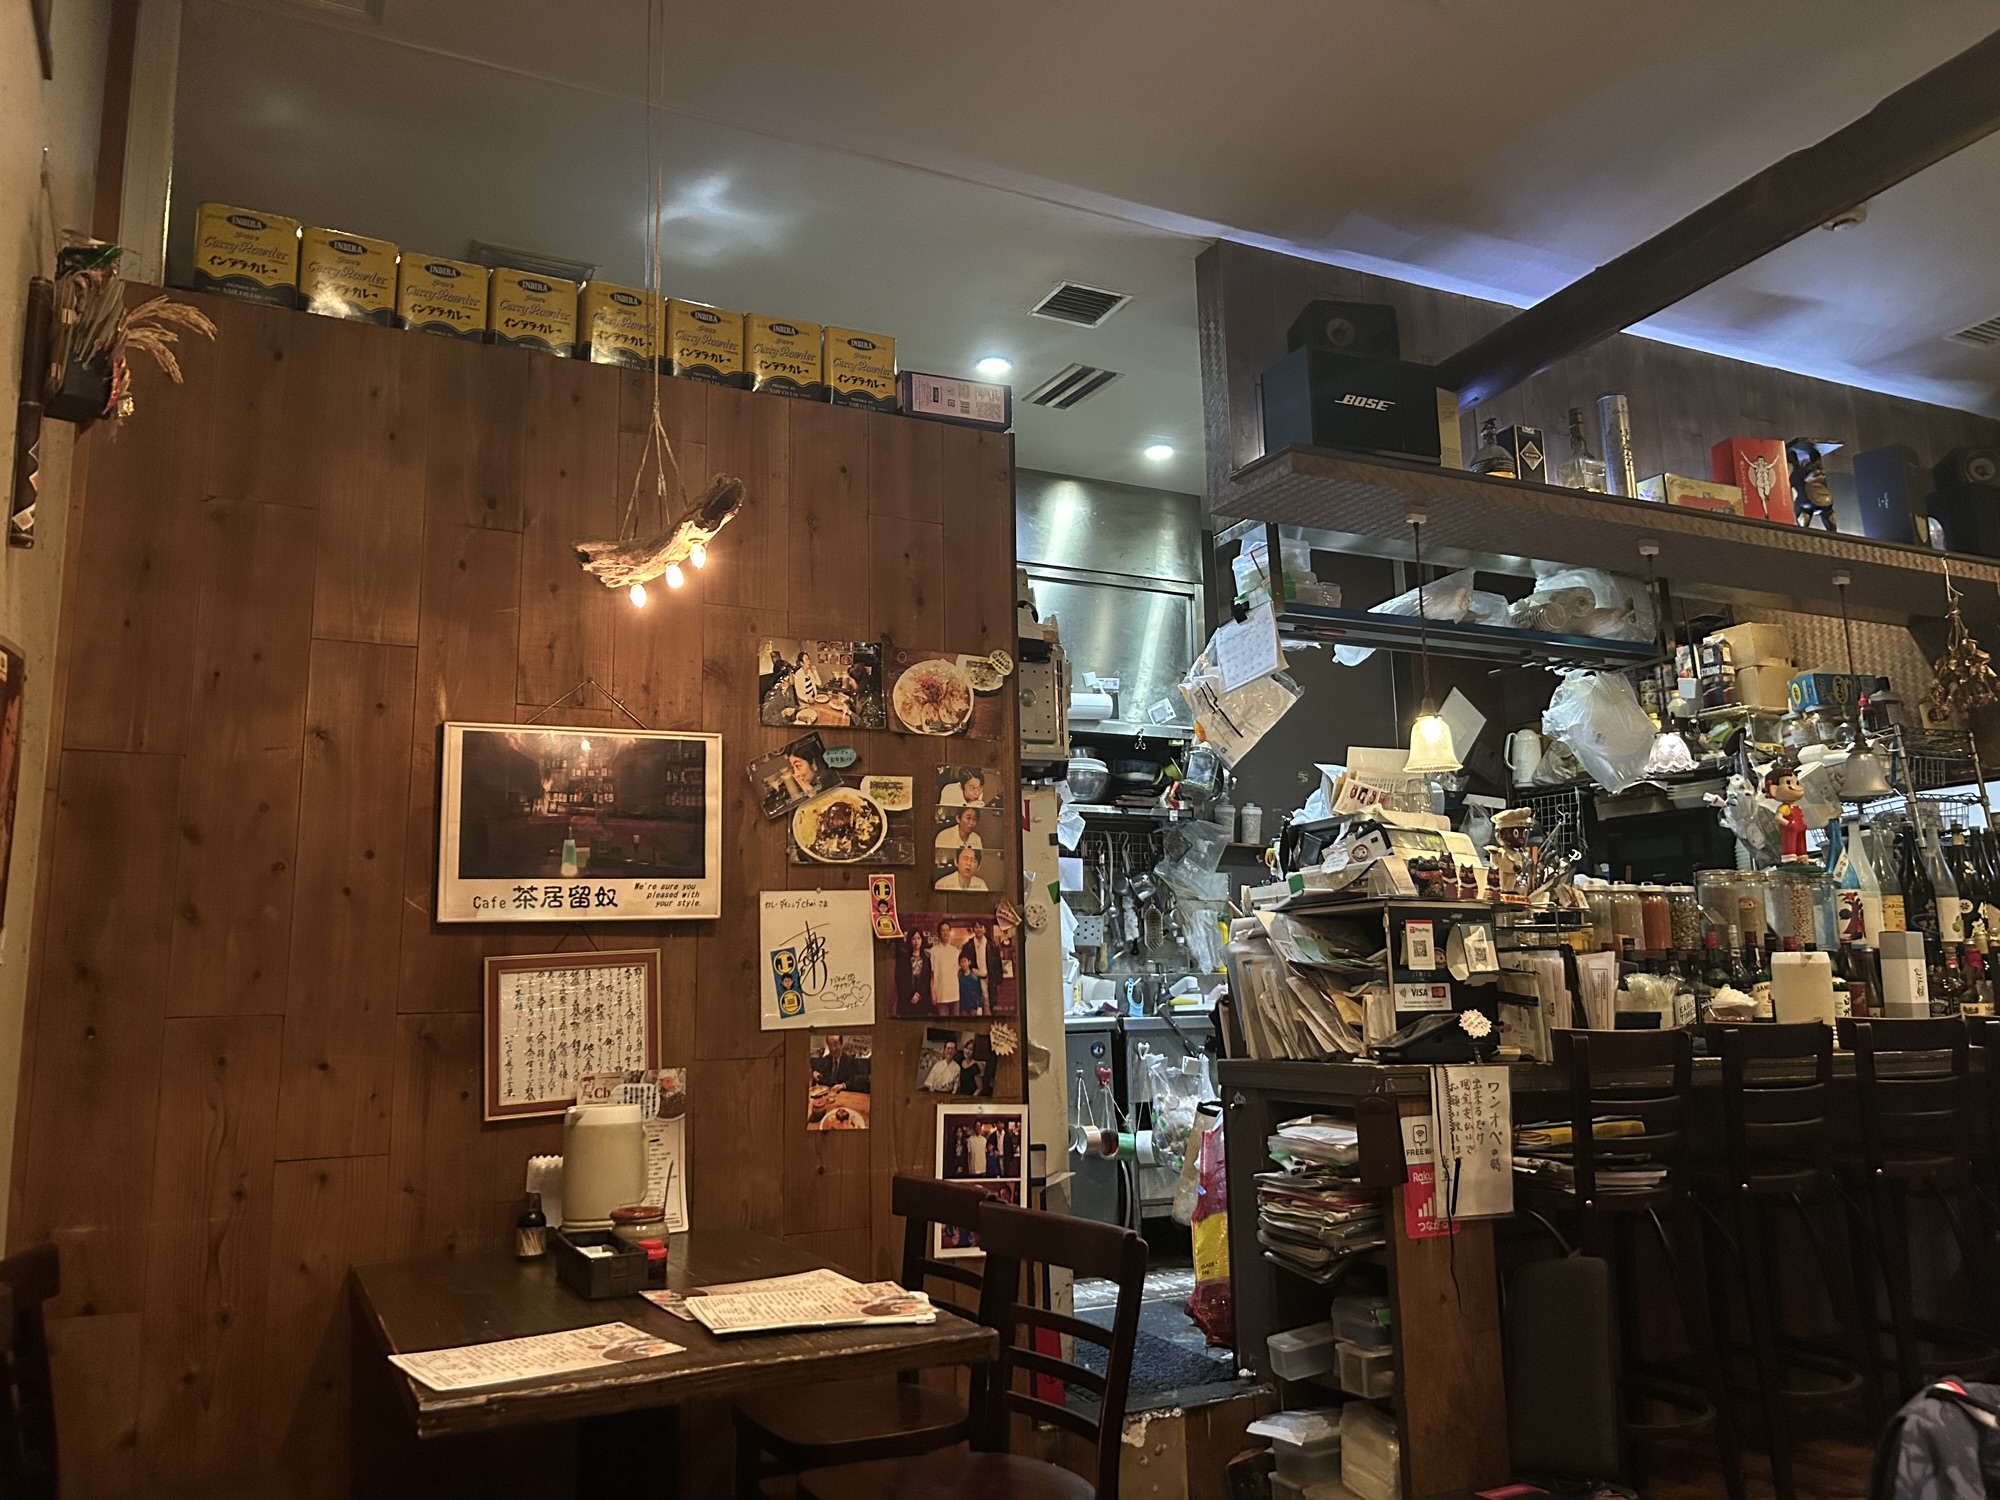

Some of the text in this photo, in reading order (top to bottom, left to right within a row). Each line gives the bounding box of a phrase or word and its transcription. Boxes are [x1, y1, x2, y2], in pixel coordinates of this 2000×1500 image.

[231, 215, 262, 229] INDIRA
[203, 236, 289, 260] Curry Powder
[334, 241, 363, 253] INDIRA
[307, 261, 388, 285] Curry Powder
[429, 265, 457, 277] INDIRA
[522, 280, 548, 292] INDIRA
[404, 285, 480, 306] Curry Powder
[614, 294, 638, 305] INDIRA
[499, 300, 571, 320] Curry Powder
[695, 311, 718, 323] INDIRA
[772, 325, 796, 335] INDIRA
[674, 330, 739, 350] Curry Powder
[850, 339, 873, 350] INDIRA
[752, 343, 816, 361] Curry Powder
[832, 357, 893, 376] Curry Powder
[1334, 394, 1396, 411] BOSE
[1700, 665, 1719, 677] STRONG
[634, 882, 657, 890] We're
[473, 885, 618, 909] Cafe 茶居留奴
[646, 891, 678, 900] pleased
[655, 899, 701, 908] your style.
[1411, 988, 1428, 997] VISA
[1460, 1077, 1476, 1155] 現金支払いで
[1472, 1077, 1486, 1145] 出来るだけ
[1488, 1081, 1503, 1172] ワンオペの時
[1406, 1148, 1425, 1156] FREE
